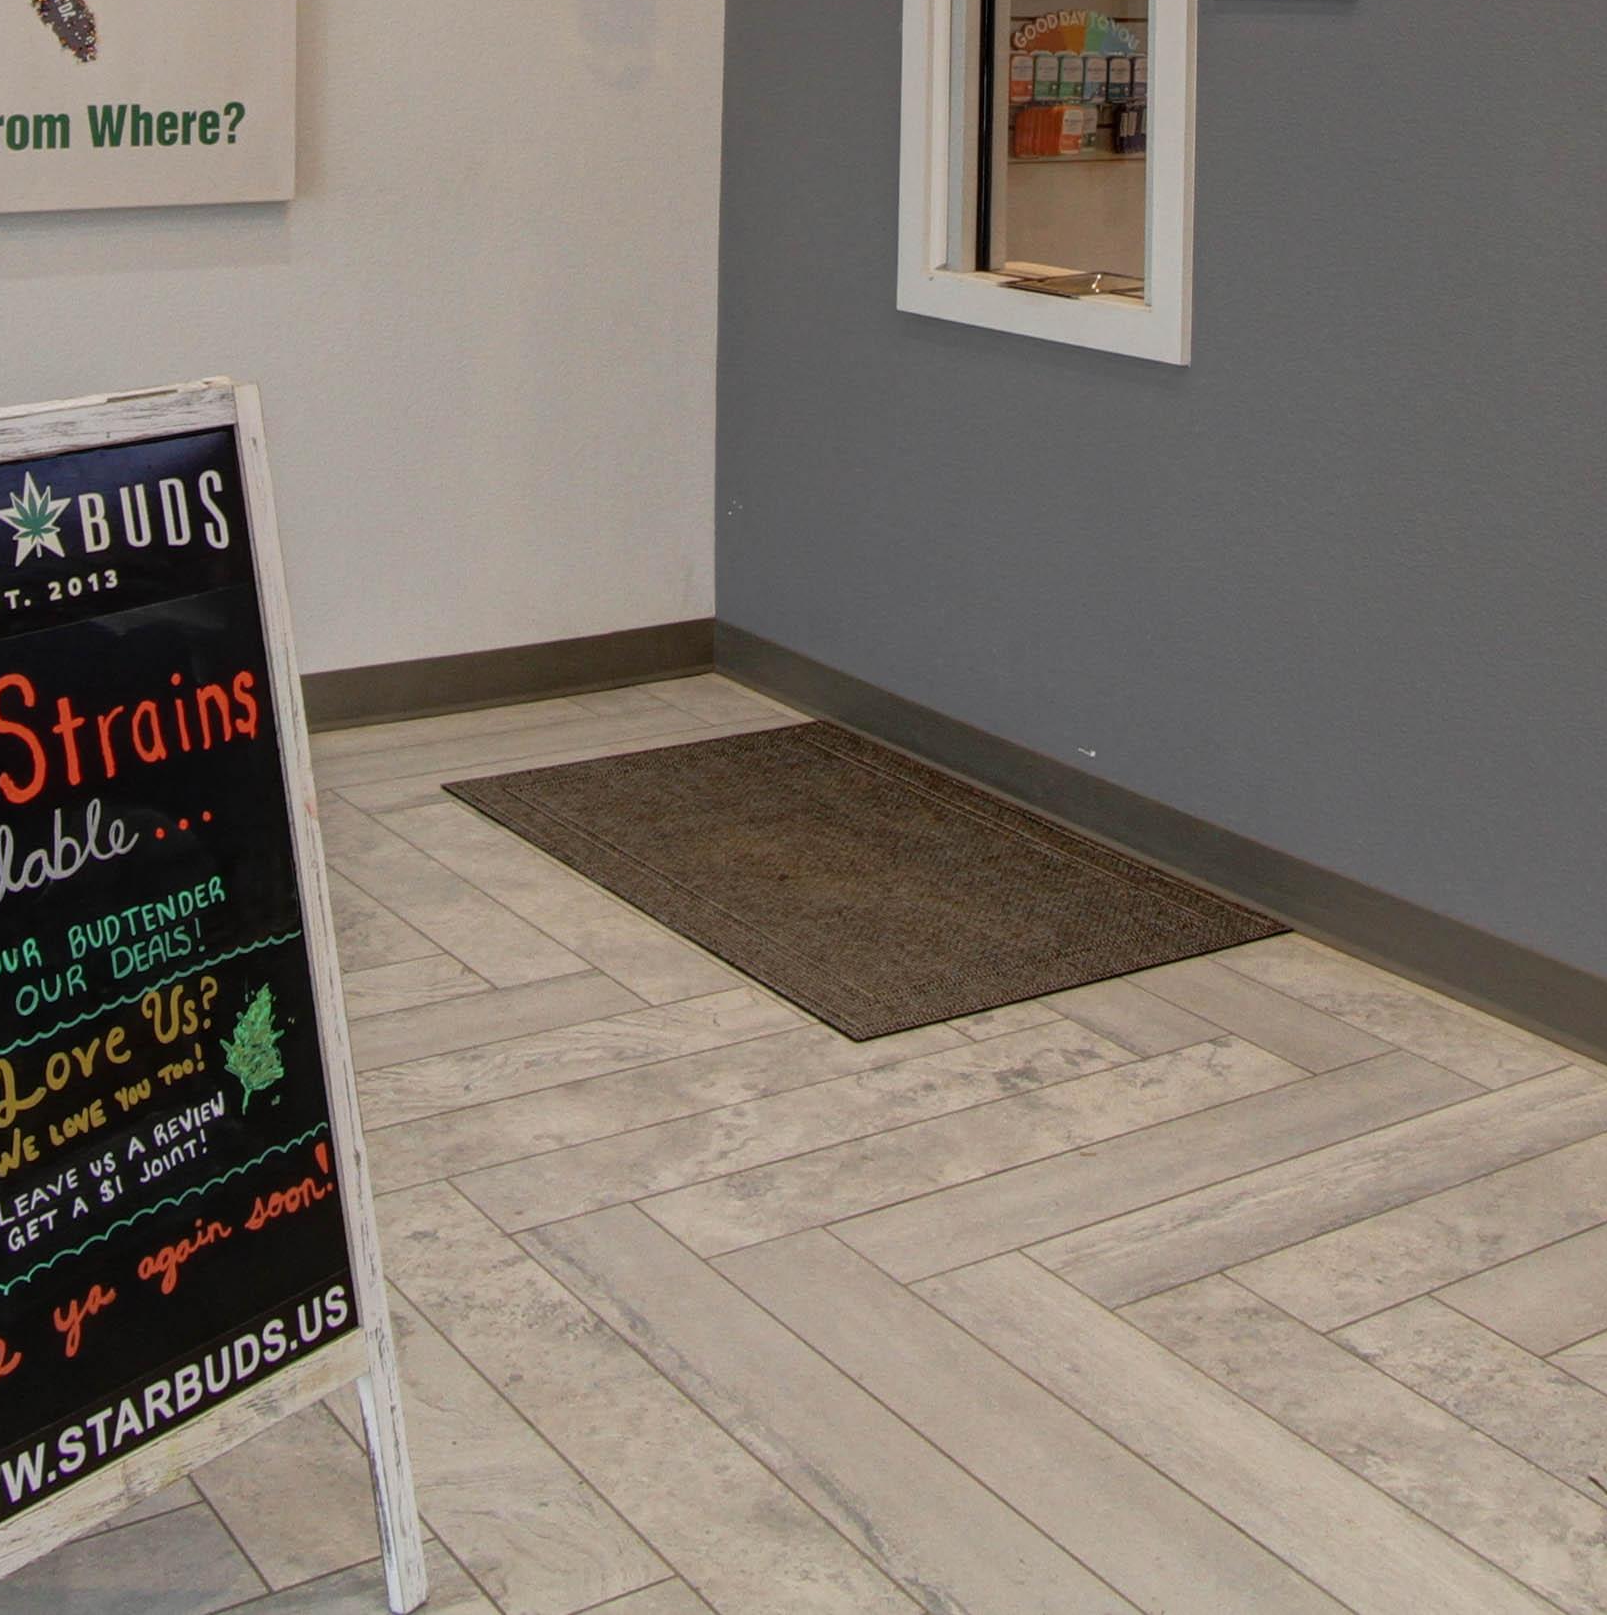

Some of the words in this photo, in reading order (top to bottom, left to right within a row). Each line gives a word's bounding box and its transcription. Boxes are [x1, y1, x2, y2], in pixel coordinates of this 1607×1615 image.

[1013, 14, 1058, 48] GOOD
[1059, 10, 1087, 25] DAY
[1110, 19, 1141, 50] YOU
[87, 101, 246, 148] Where?
[78, 469, 230, 554] BUDS
[48, 569, 119, 603] 2013
[69, 876, 226, 960] BUDTENDER
[15, 963, 87, 1015] OUR
[112, 918, 207, 980] DEALS!
[50, 1098, 107, 1146] LOVE
[115, 1073, 151, 1112] YOU
[158, 1043, 205, 1087] TOO!
[90, 1152, 116, 1176] US
[127, 1137, 146, 1161] A
[153, 1090, 226, 1145] REVIEW
[7, 1211, 58, 1254] GET
[72, 1196, 89, 1220] A
[99, 1175, 124, 1205] $1
[139, 1132, 208, 1185] JOINT!
[53, 1283, 117, 1357] ya
[137, 1219, 231, 1295] again
[245, 1141, 334, 1232] soon!
